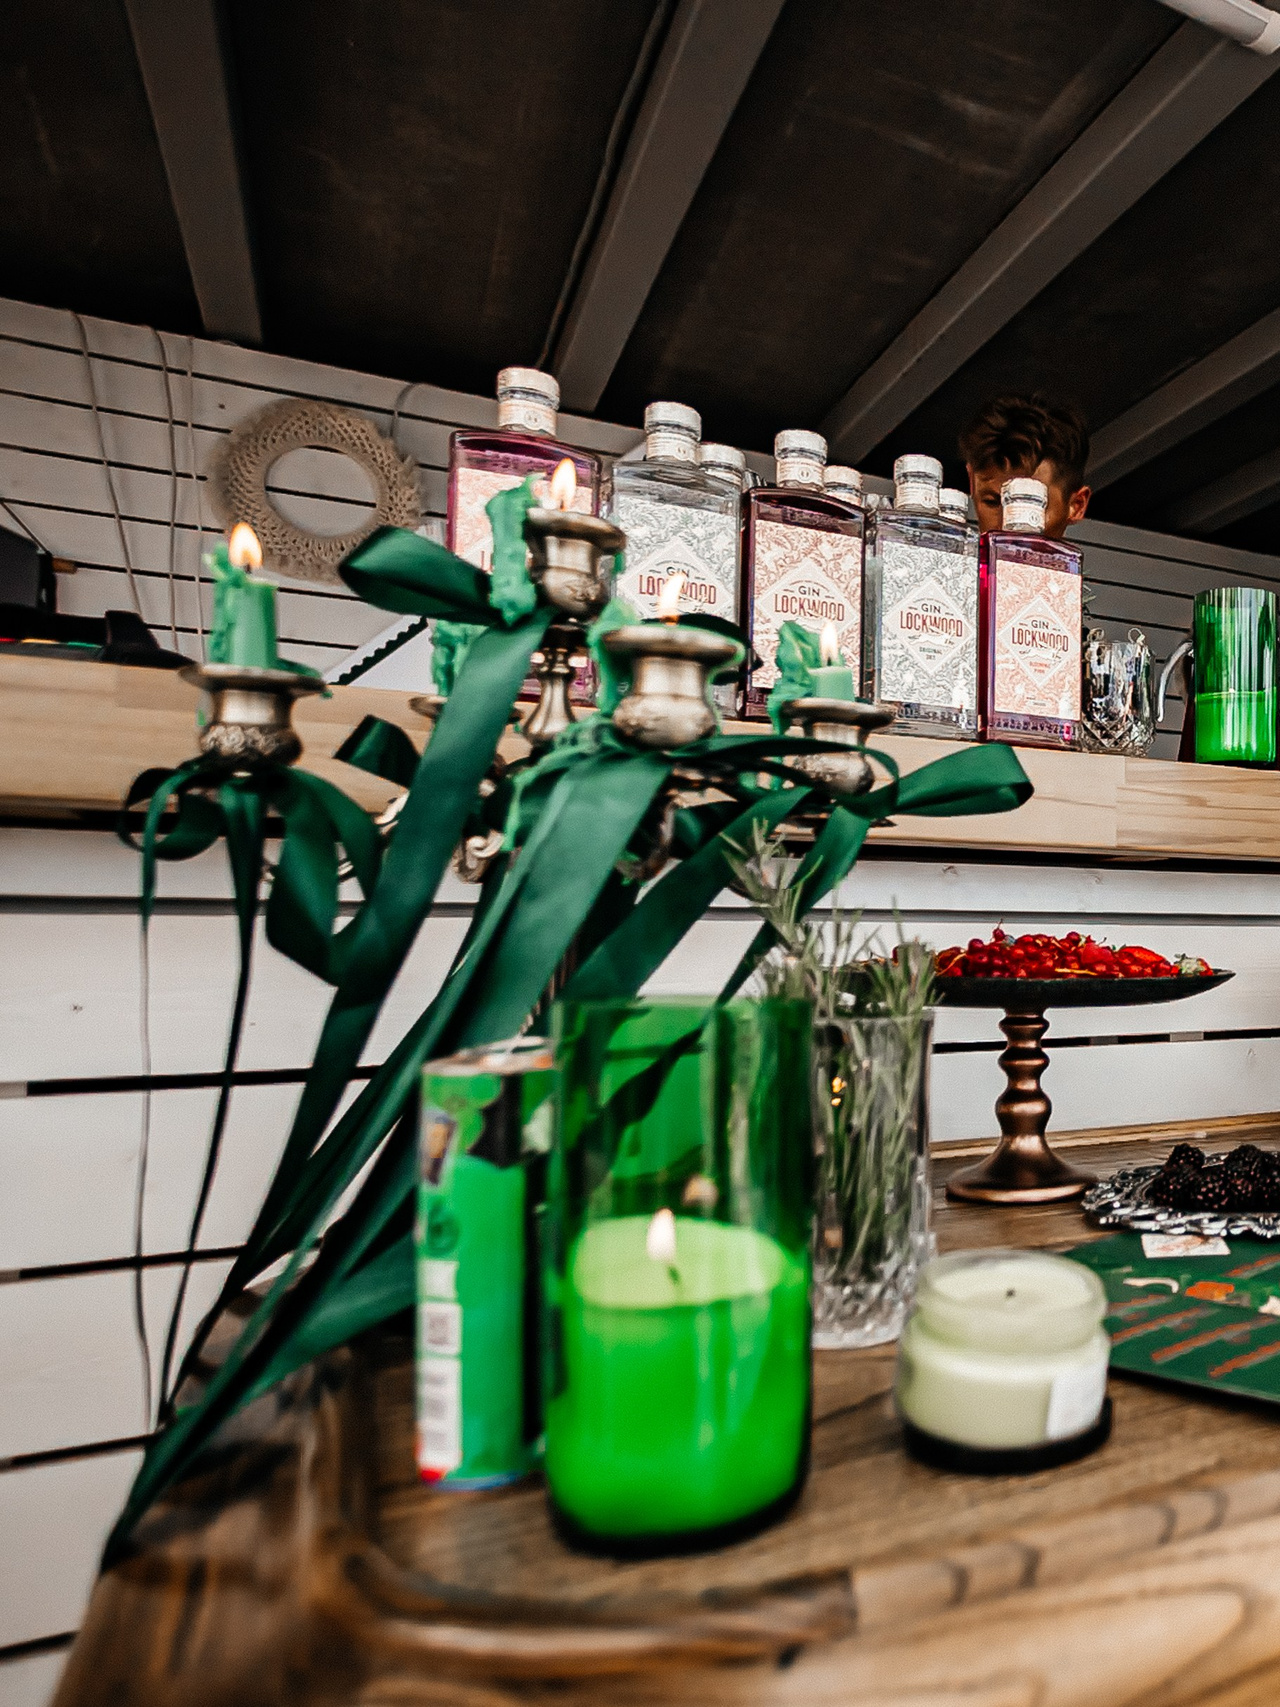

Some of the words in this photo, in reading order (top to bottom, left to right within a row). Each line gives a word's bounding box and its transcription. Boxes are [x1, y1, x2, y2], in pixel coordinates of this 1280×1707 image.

[638, 574, 717, 605] LOCWOOD
[798, 585, 820, 597] GIN
[774, 594, 845, 622] LOCKWOOD
[921, 603, 941, 614] GIN
[900, 610, 963, 637] LOCKWOOD
[1031, 619, 1049, 629] GIN
[1011, 627, 1069, 652] LOCKWOOD
